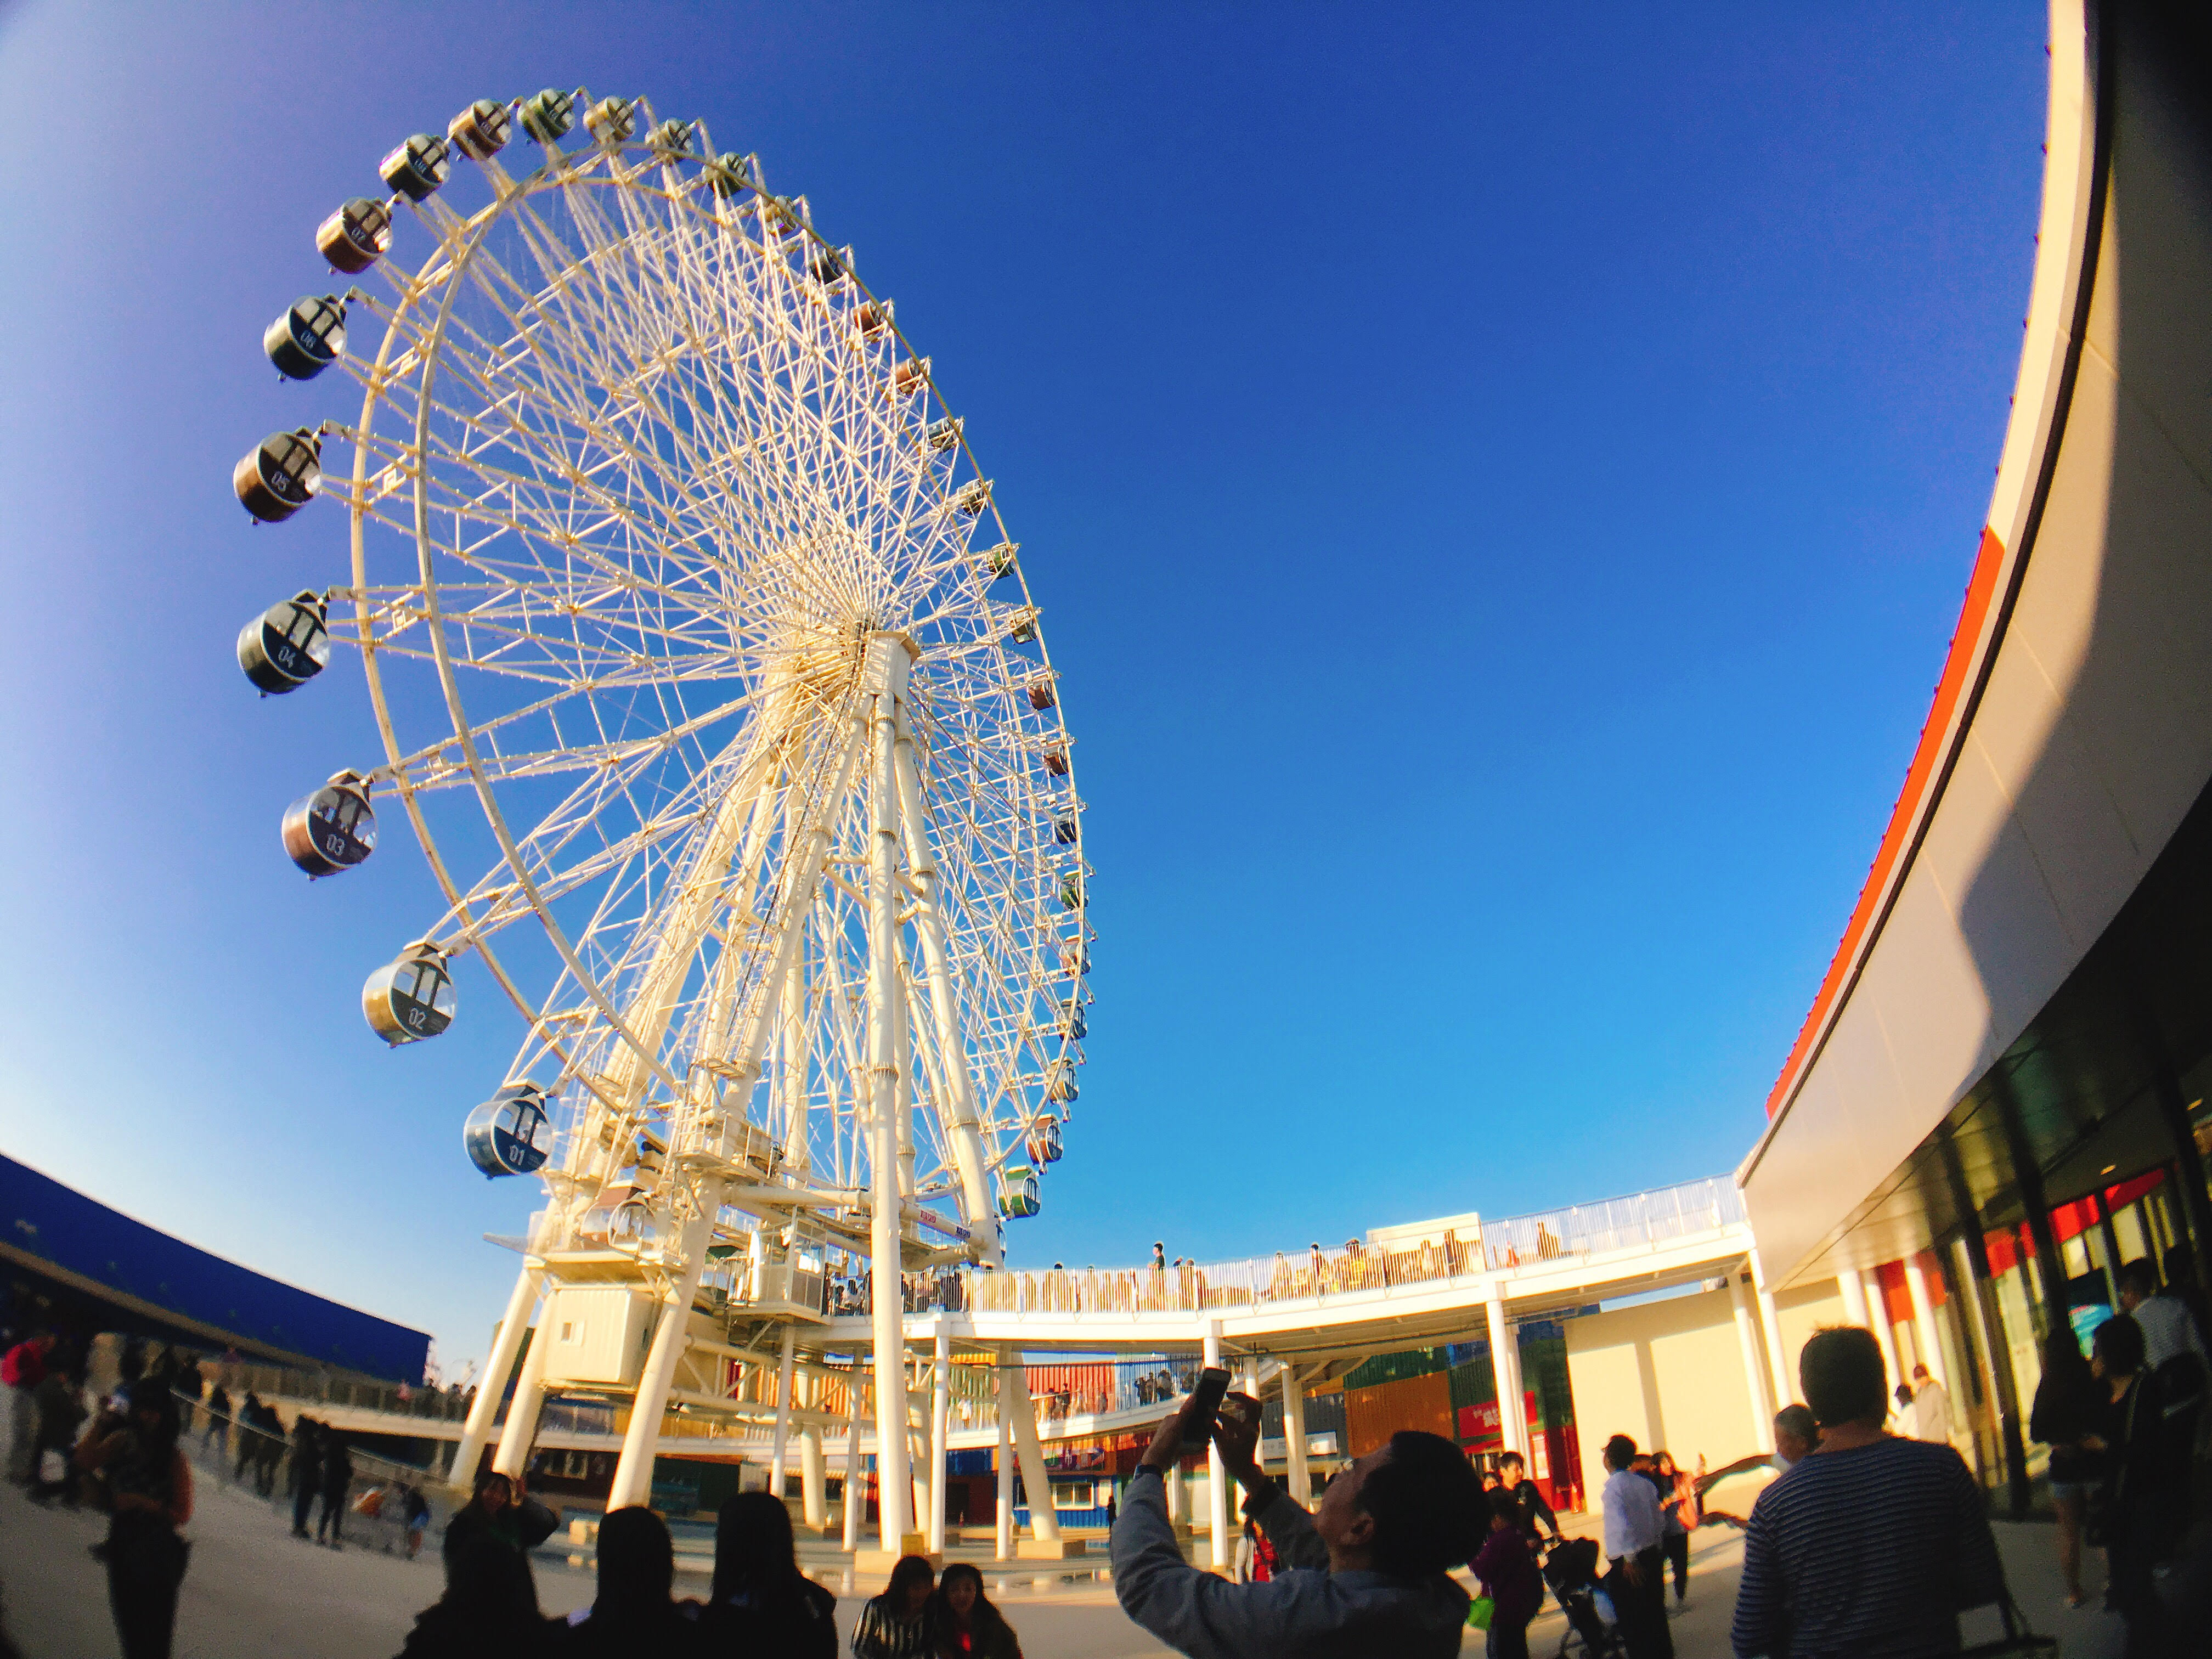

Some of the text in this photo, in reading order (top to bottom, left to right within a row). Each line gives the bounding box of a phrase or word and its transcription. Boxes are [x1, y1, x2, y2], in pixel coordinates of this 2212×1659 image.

[271, 471, 290, 492] 05
[278, 646, 296, 669] 04
[326, 833, 346, 856] 03
[408, 1007, 426, 1030] 02
[509, 1144, 525, 1166] 01
